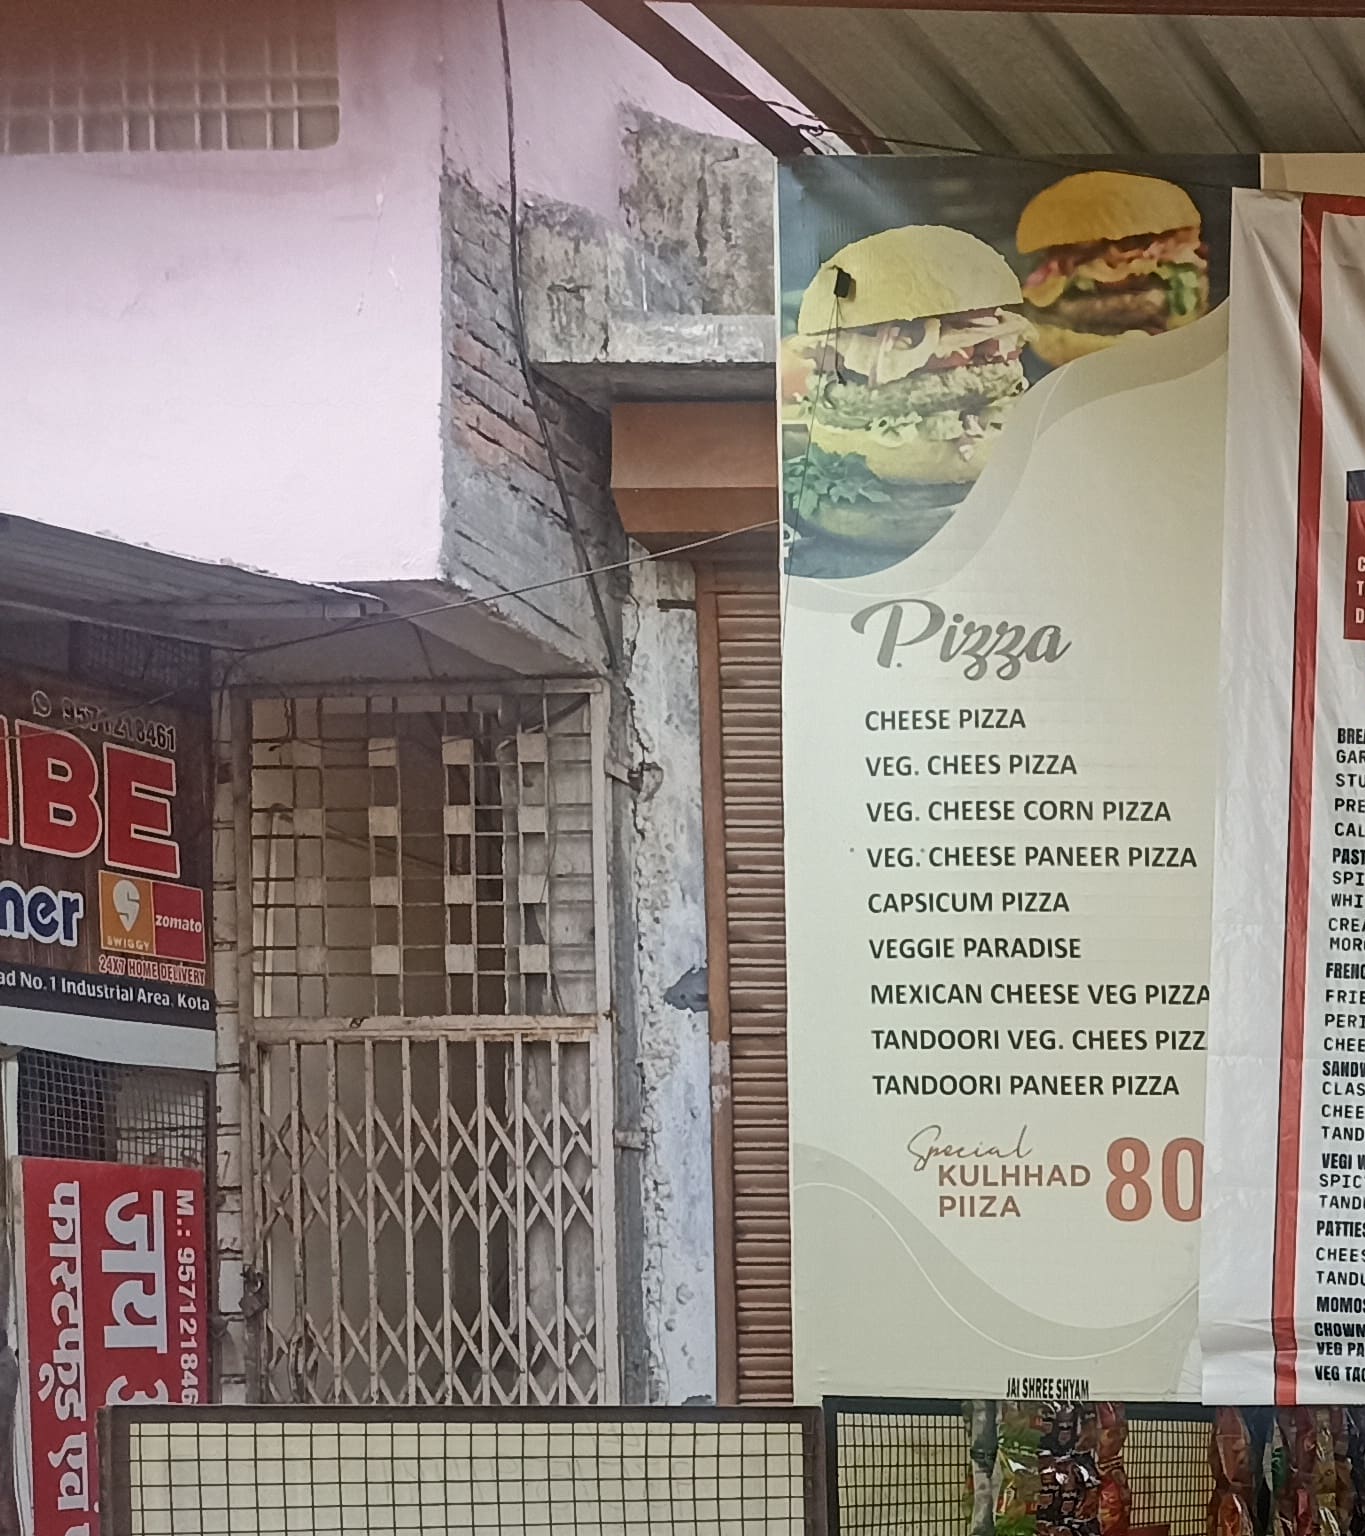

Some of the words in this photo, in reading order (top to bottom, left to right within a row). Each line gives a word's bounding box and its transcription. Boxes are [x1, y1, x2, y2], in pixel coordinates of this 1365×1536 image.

[850, 598, 1072, 681] Pizza
[865, 709, 950, 732] CHEESE
[959, 708, 1026, 729] PIZZA
[865, 755, 919, 777] VEG.
[927, 754, 1001, 776] CHEES
[1009, 754, 1077, 775] PIZZA
[0, 714, 179, 878] BE
[866, 801, 920, 823] VEG.
[928, 800, 1015, 822] CHEESE
[1023, 800, 1094, 821] CORN
[1103, 801, 1172, 822] PIZZA
[866, 847, 921, 868] VEG.
[928, 845, 1017, 867] CHEESE
[1025, 846, 1120, 867] PANEER
[1128, 846, 1198, 868] PIZZA
[868, 892, 993, 914] CAPSICUM
[1002, 892, 1070, 913] PIZZA
[156, 914, 201, 932] zomato
[107, 936, 150, 951] SWIGGY
[868, 938, 955, 959] VEGGIE
[963, 937, 1081, 959] PARADISE
[128, 958, 158, 979] HOME
[160, 966, 205, 986] DELIVERY
[61, 978, 133, 1001] Industrial
[178, 993, 210, 1011] Kota
[871, 983, 983, 1005] MEXICAN
[990, 983, 1080, 1005] CHEESE
[1087, 984, 1137, 1005] VEG
[1145, 984, 1210, 1005] PIZZA
[871, 1029, 999, 1050] TANDOORI
[1007, 1029, 1064, 1051] VEG.
[1072, 1029, 1148, 1051] CHEES
[1155, 1030, 1207, 1051] PIZZ
[872, 1074, 1001, 1096] TANDOORI
[1010, 1075, 1104, 1096] PANEER
[1112, 1075, 1180, 1096] PIZZA
[906, 1124, 1033, 1172] Special
[937, 1163, 1091, 1187] KULHHAD
[1106, 1137, 1204, 1222] 80
[939, 1195, 1021, 1218] PIIZA
[102, 1190, 167, 1353] जय
[1006, 1377, 1020, 1399] JAI
[1022, 1377, 1054, 1399] SHREE
[1055, 1378, 1089, 1400] SHYAM
